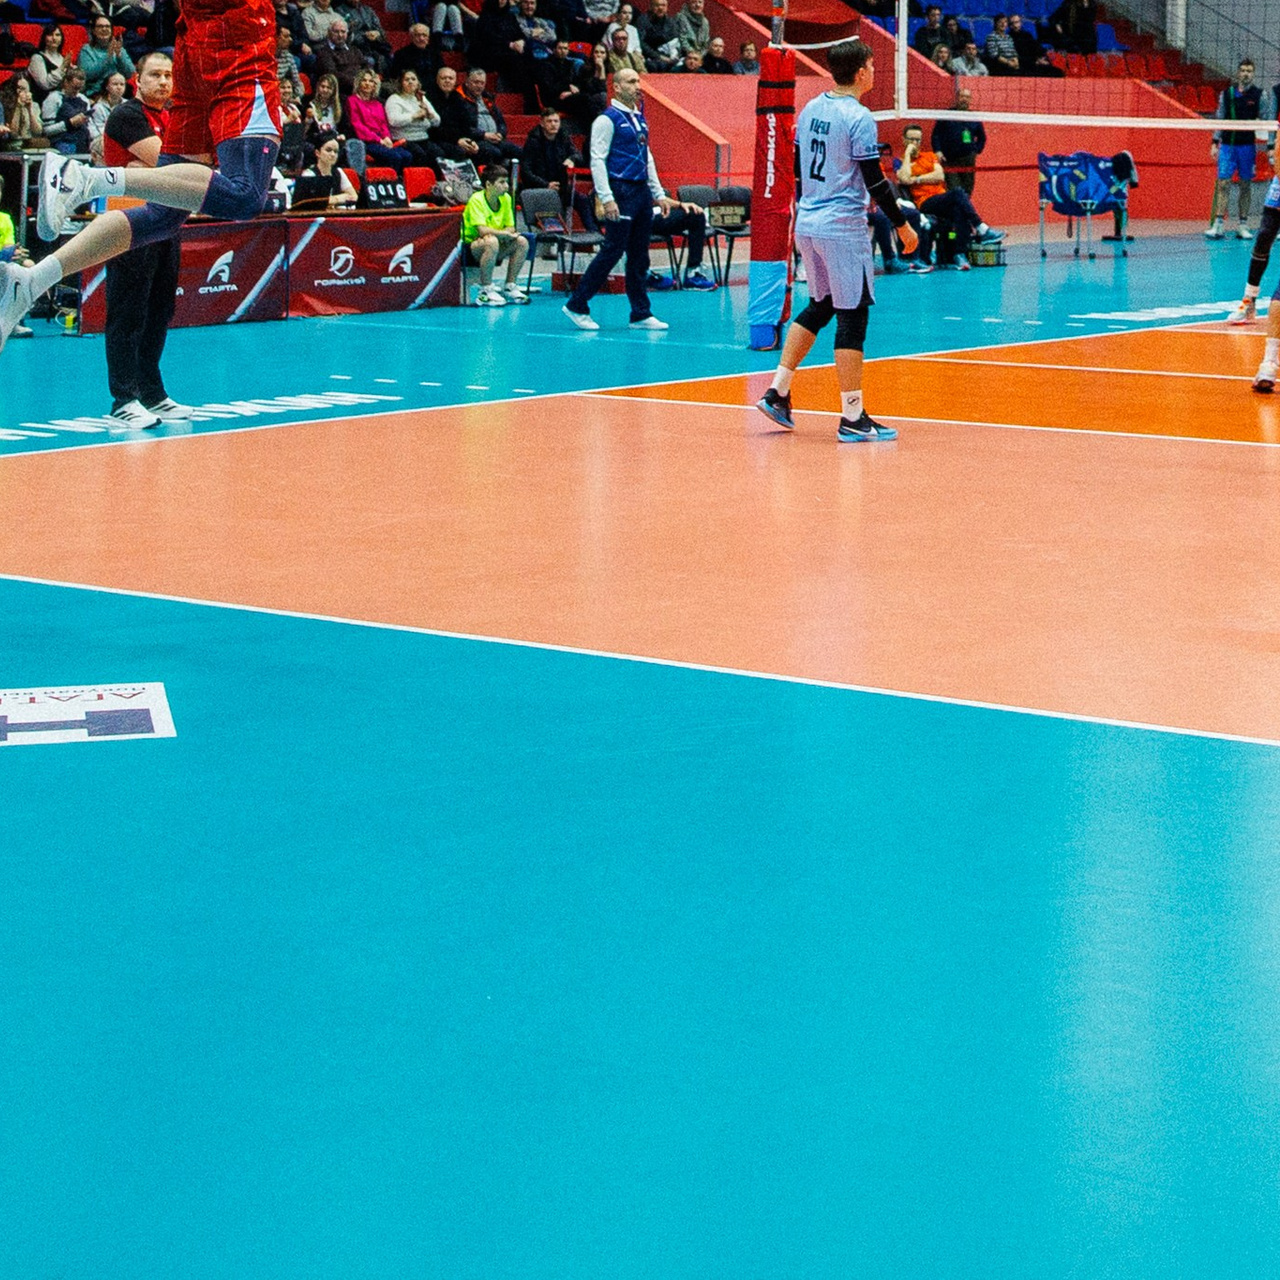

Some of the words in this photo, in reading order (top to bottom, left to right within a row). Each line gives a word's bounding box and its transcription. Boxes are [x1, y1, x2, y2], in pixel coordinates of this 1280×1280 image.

[809, 138, 826, 182] 22
[315, 276, 366, 286] ГОРЬКИЙ
[381, 275, 420, 284] СПАРТА
[198, 283, 238, 295] СПАРТА
